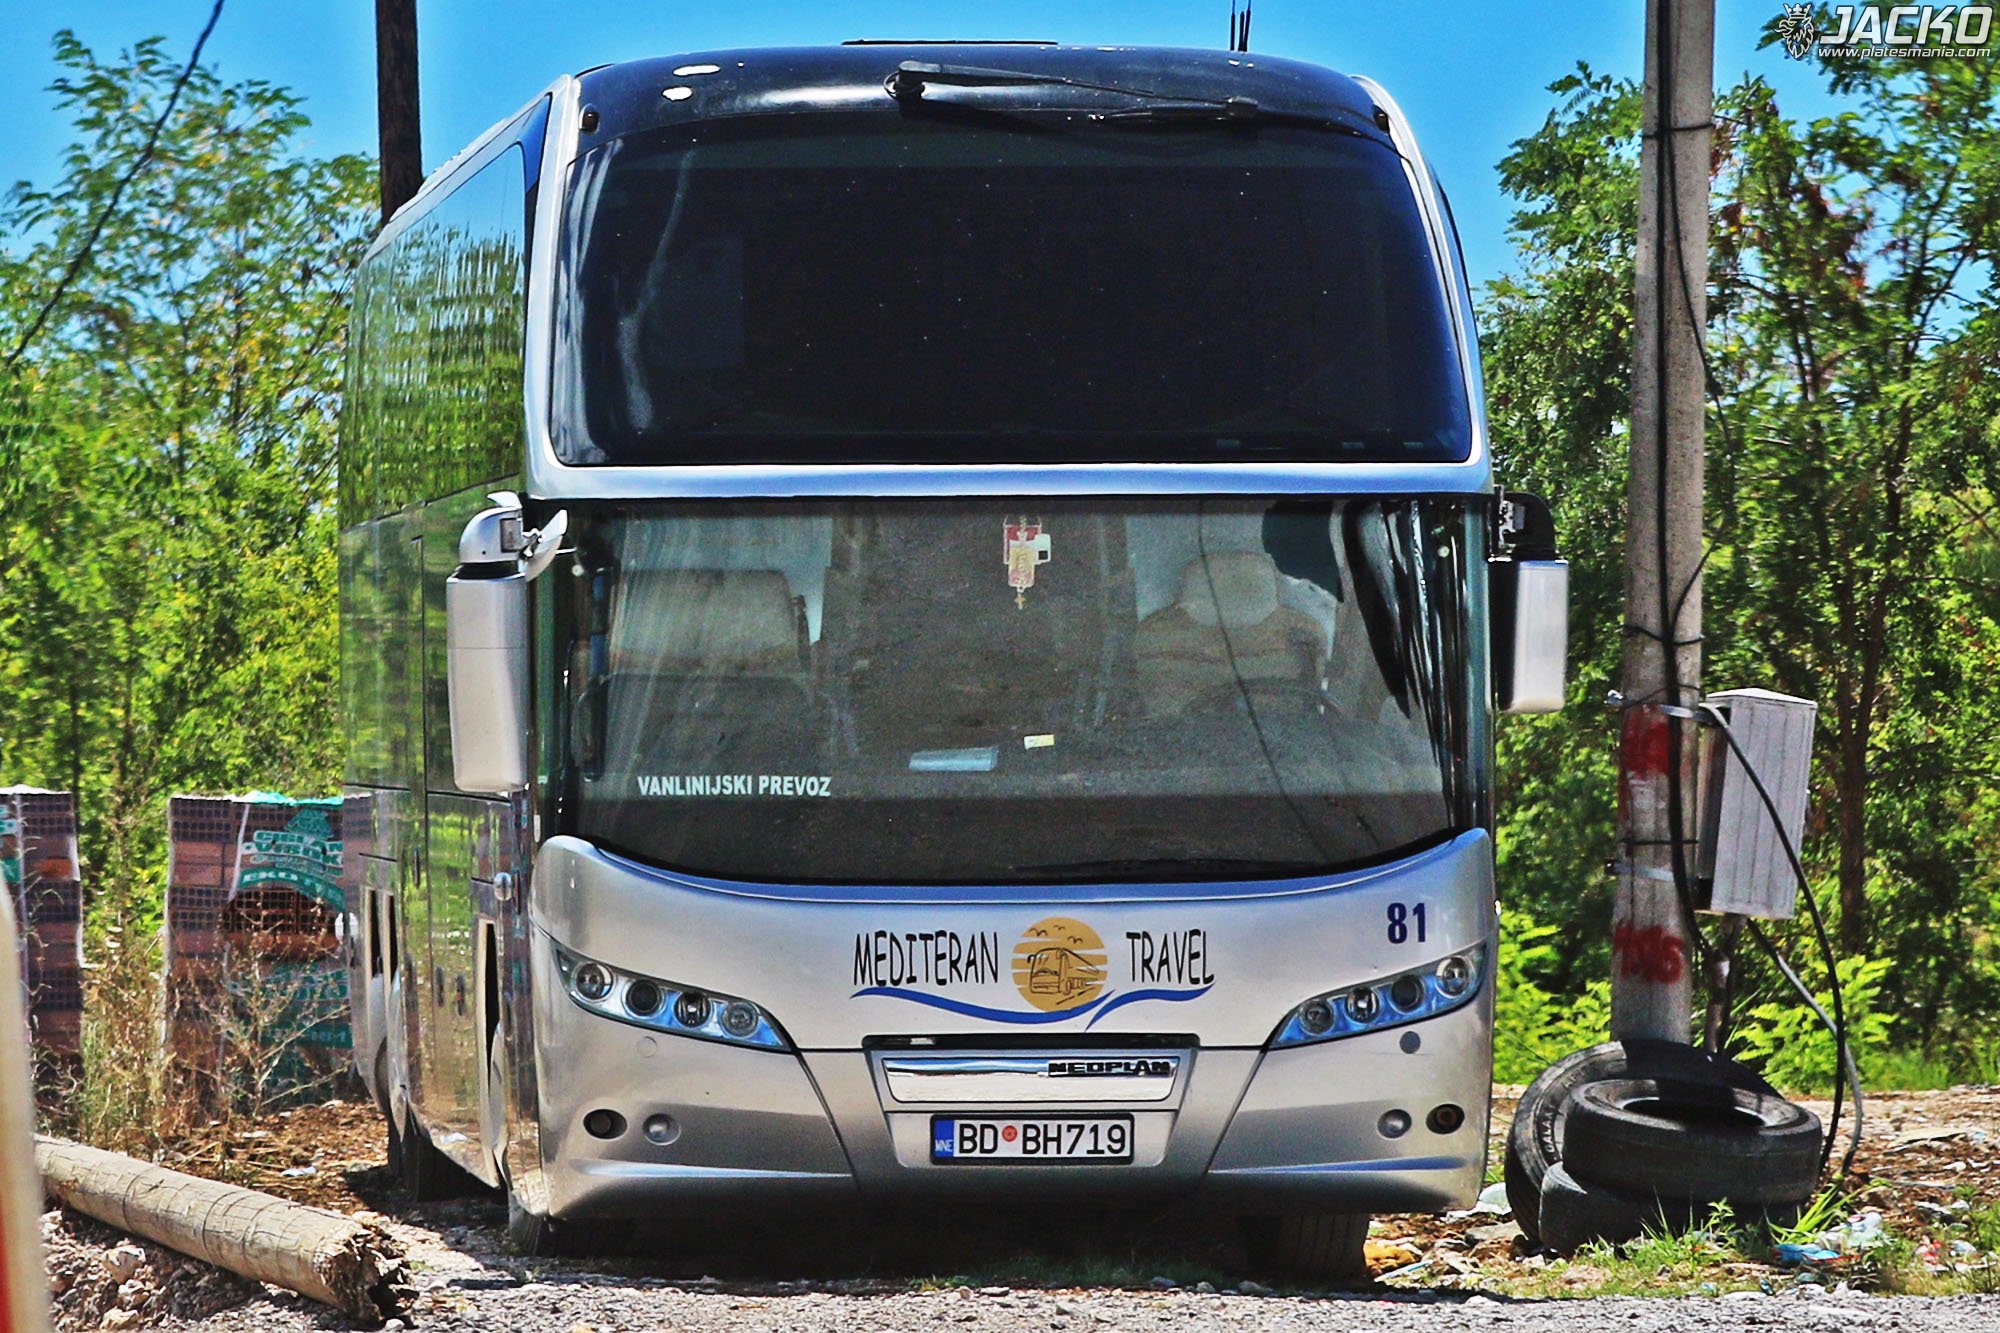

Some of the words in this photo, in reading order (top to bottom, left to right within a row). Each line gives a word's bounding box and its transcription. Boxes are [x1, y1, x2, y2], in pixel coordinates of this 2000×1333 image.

[637, 775, 752, 796] VANLINIJSKI
[758, 776, 832, 797] PREVOZ
[1387, 902, 1426, 944] 81
[853, 930, 999, 987] MEDITERAN
[1126, 929, 1215, 985] TRAVEL
[1048, 1060, 1171, 1076] NEOPLAN
[959, 1123, 999, 1155] BD
[1022, 1123, 1126, 1155] BH719
